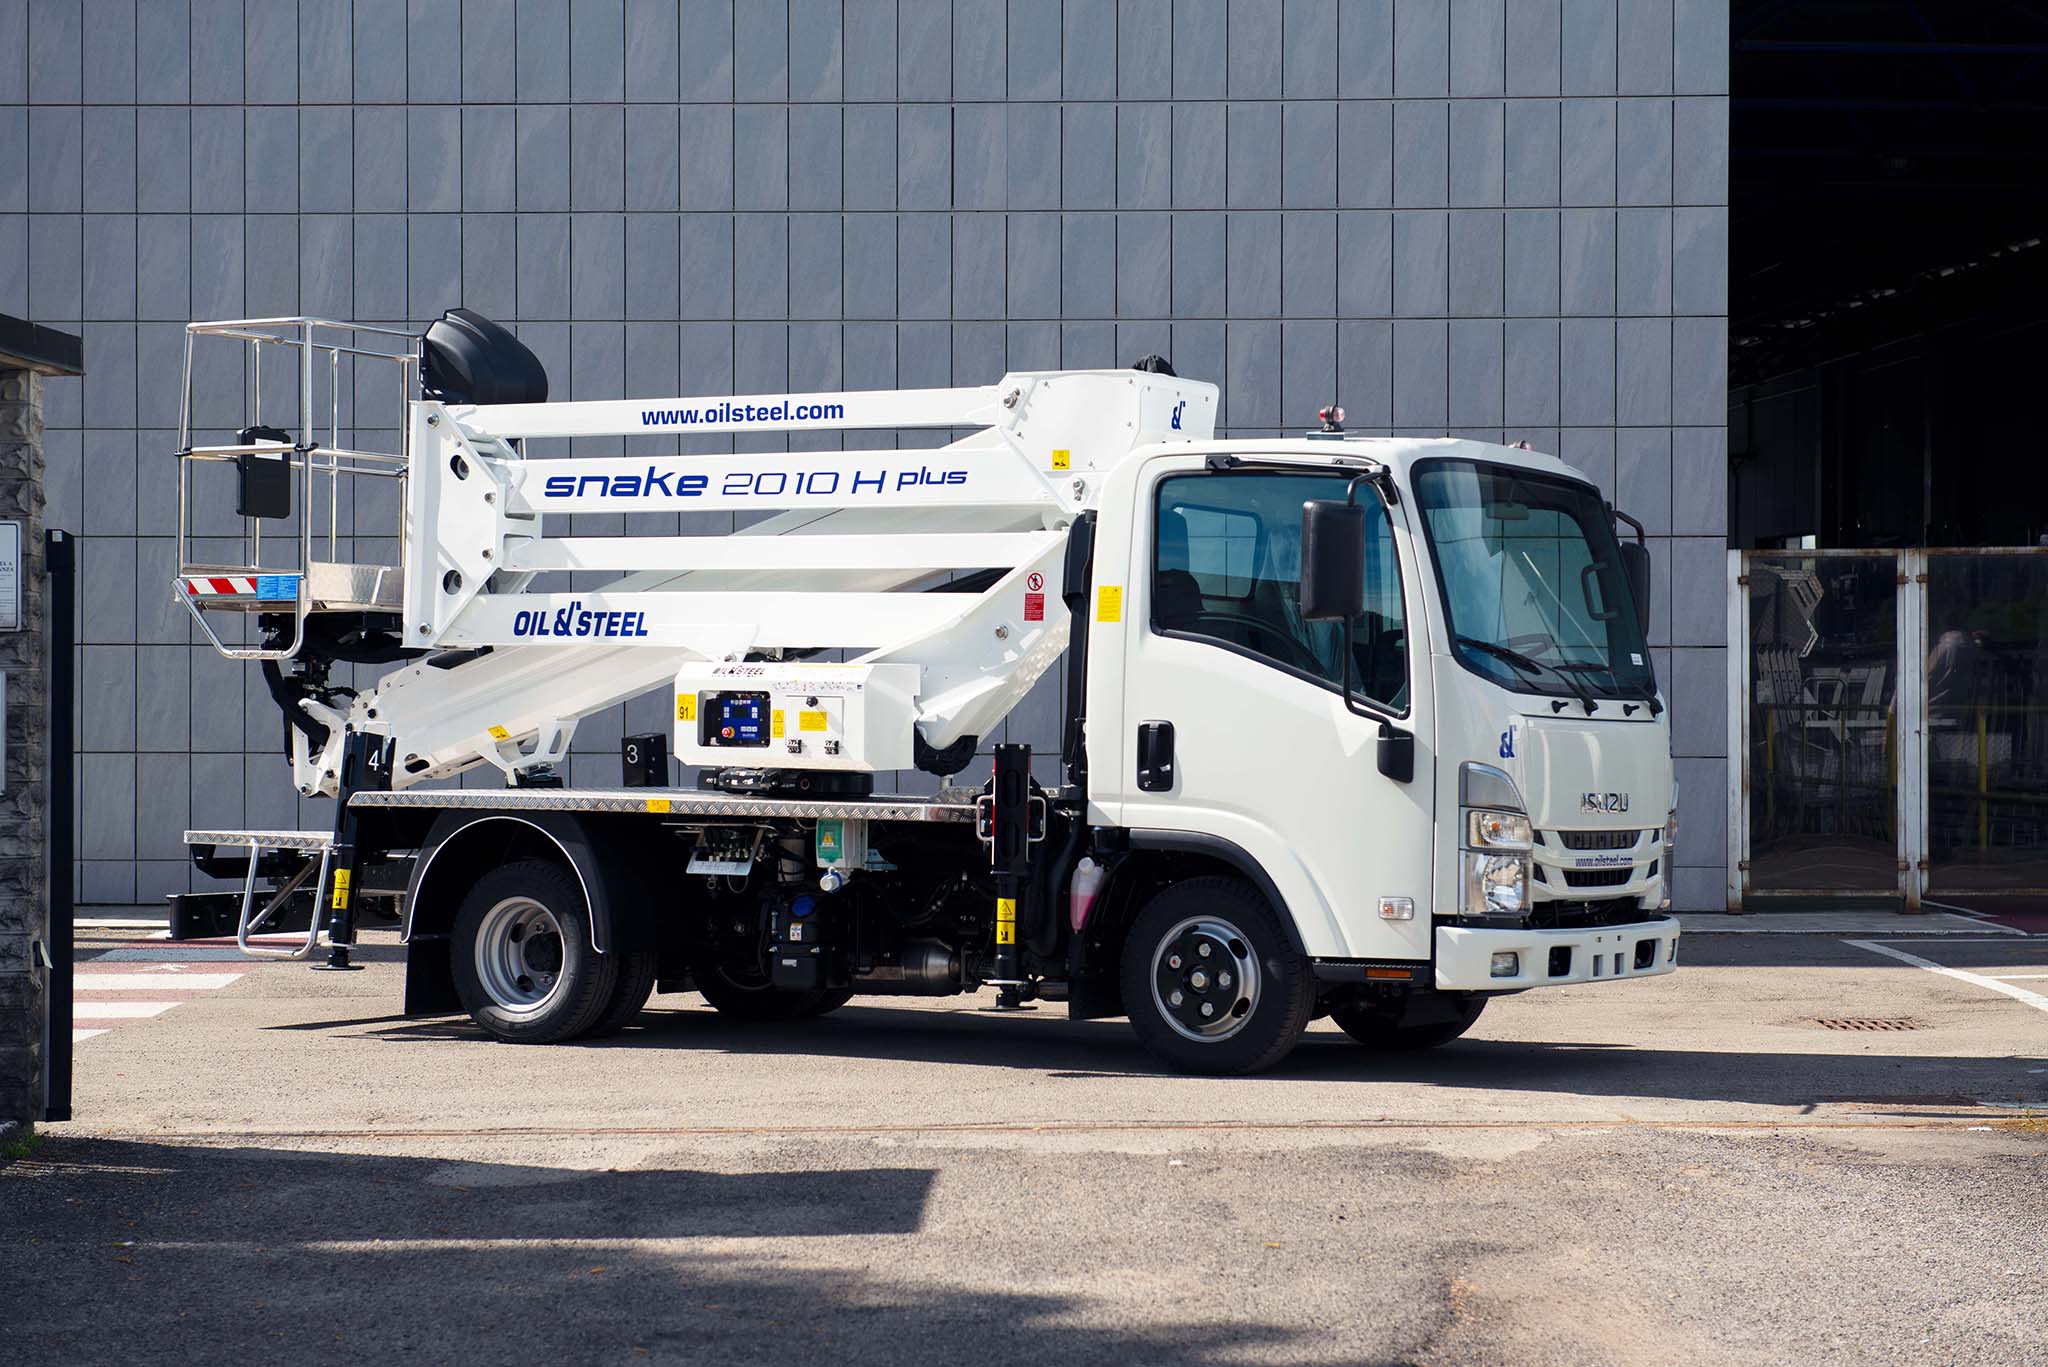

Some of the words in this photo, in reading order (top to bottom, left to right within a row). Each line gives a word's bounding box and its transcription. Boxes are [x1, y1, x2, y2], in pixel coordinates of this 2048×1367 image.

[642, 400, 844, 425] www.oilsteel.com
[544, 466, 709, 497] snake
[722, 472, 840, 495] 2010
[851, 470, 887, 494] H
[896, 466, 968, 492] plus
[679, 705, 689, 719] 91
[368, 749, 380, 771] 4
[627, 744, 638, 764] 3
[1582, 792, 1629, 812] ISUZU
[1575, 855, 1633, 867] www.oilsteel.com
